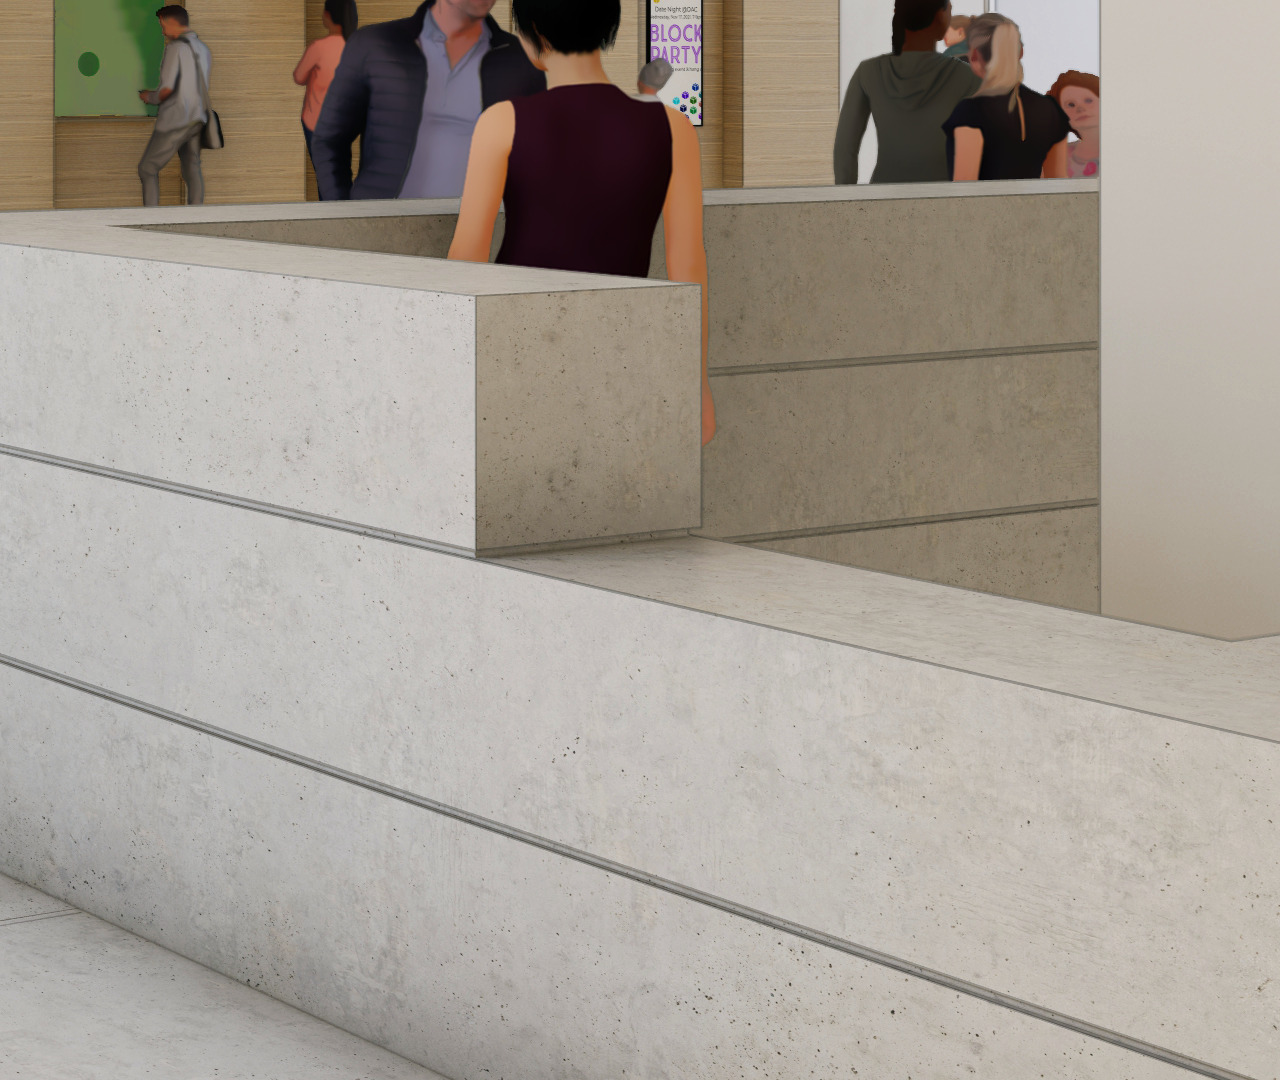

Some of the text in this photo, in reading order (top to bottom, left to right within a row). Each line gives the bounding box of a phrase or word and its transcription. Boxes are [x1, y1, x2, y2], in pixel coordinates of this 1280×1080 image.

[667, 6, 681, 14] Night
[651, 24, 701, 42] BLOCK
[651, 46, 701, 64] PARTY
